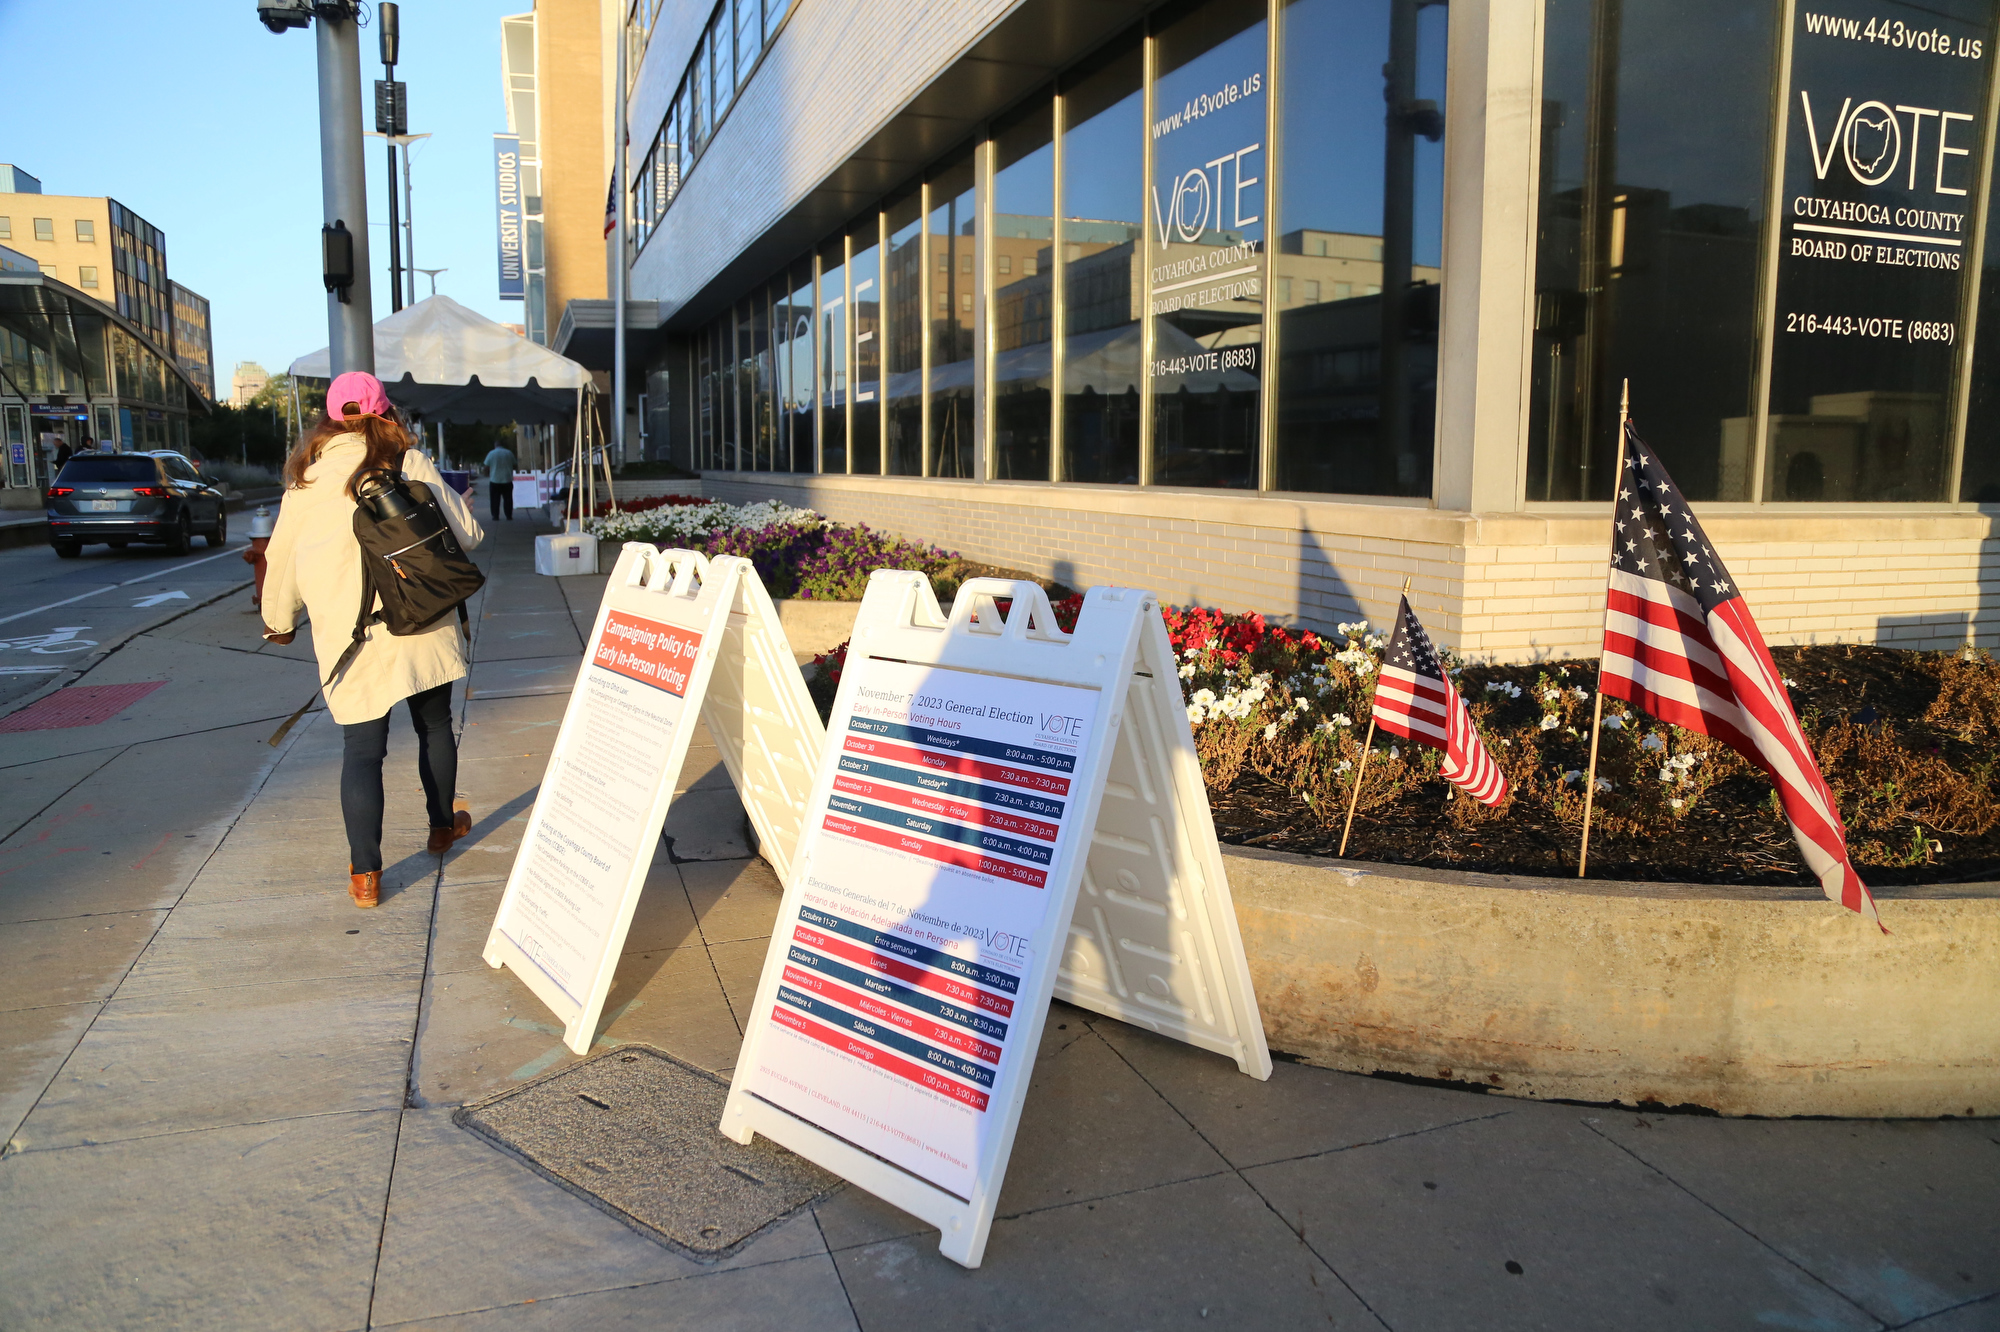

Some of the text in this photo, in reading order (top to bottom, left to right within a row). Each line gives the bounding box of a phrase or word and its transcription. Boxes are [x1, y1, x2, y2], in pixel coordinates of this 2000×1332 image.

[1806, 12, 1982, 59] www.443vote.us
[1152, 72, 1261, 139] www.443vote.us
[1801, 90, 1973, 196] VOTE
[1152, 143, 1259, 250] VOTE
[498, 152, 520, 280] UNIVERSITY STUDIOS
[1794, 196, 1963, 232] CUYAHOGA COUNTY
[1152, 240, 1258, 284] CUYAHOGA COUNTY
[1791, 238, 1960, 270] BOARD OF ELECTIONS
[1152, 278, 1257, 316] BOARD OF ELECTIONS
[1786, 312, 1955, 345] 216-443-VOTE (8683)
[773, 278, 874, 415] VOTE
[1150, 347, 1256, 377] 216-443-VOTE (8683)
[606, 618, 699, 659] Campaigning Policy for
[597, 643, 686, 691] Early In-Person Voting
[852, 702, 962, 730] Early In-Person Voting Hours
[857, 686, 1034, 725] November 7, 2023 General Election
[851, 719, 888, 733] October 11-27
[1040, 713, 1083, 737] VOTE
[846, 739, 875, 752] October 30
[1005, 748, 1072, 769] 8:00 a.m. 5:00 p.m.
[839, 757, 869, 772] October 31
[921, 755, 947, 769] Monday
[835, 778, 872, 794] November 1-3
[1000, 770, 1066, 791] 7:30 a.m. 7:30 p.m.
[830, 798, 858, 812] November
[911, 797, 969, 819] Wednesday Friday
[994, 792, 1060, 814] 7:30 a.m. 8:30 p.m.
[825, 818, 857, 834] November 5
[905, 817, 933, 833] Saturday
[989, 814, 1055, 837] 7:30 a.m. 7:30 p.m.
[900, 837, 923, 852] Sunday
[982, 836, 1048, 860] 8:00 a.m. 4:00 p.m.
[978, 859, 1043, 884] 1:00 p.m. 5:00 p.m.
[801, 909, 838, 928] Octubre 11-27
[803, 891, 960, 950] Horario de Votación Adelantada en Persona
[807, 876, 985, 940] Elecciones Generales del 7 de Noviembre de 2023
[796, 929, 825, 946] Octubre 30
[874, 935, 890, 948] Entre
[986, 927, 1028, 958] VOTE
[789, 947, 819, 966] Octubre 31
[870, 957, 888, 970] Lunes
[785, 969, 823, 990] Noviembre 1-3
[950, 960, 1016, 990] 8:00 a.m. 5:00 p.m.
[779, 989, 812, 1009] Noviembre 4
[945, 983, 1010, 1013] 7:30 a.m. 7:30 p.m.
[774, 1009, 806, 1030] Noviembre 5
[859, 999, 913, 1027] Miércoles Viernes
[940, 1005, 1003, 1036] 7:30 a.m. 8:30 p.m.
[853, 1020, 875, 1036] Sábado
[847, 1042, 874, 1060] Domingo
[934, 1027, 997, 1059] 7:30 a.m. 7:30 p.m.
[927, 1050, 991, 1083] 8:00 a.m. 4:00 p.m.
[770, 1070, 789, 1084] EUCLID
[787, 1079, 809, 1096] AVENUE
[810, 1089, 841, 1110] CLEVELAND,
[841, 1104, 851, 1114] OH
[851, 1109, 866, 1121] 44115
[923, 1073, 985, 1107] 1:00 p.m. 5:00 p.m.
